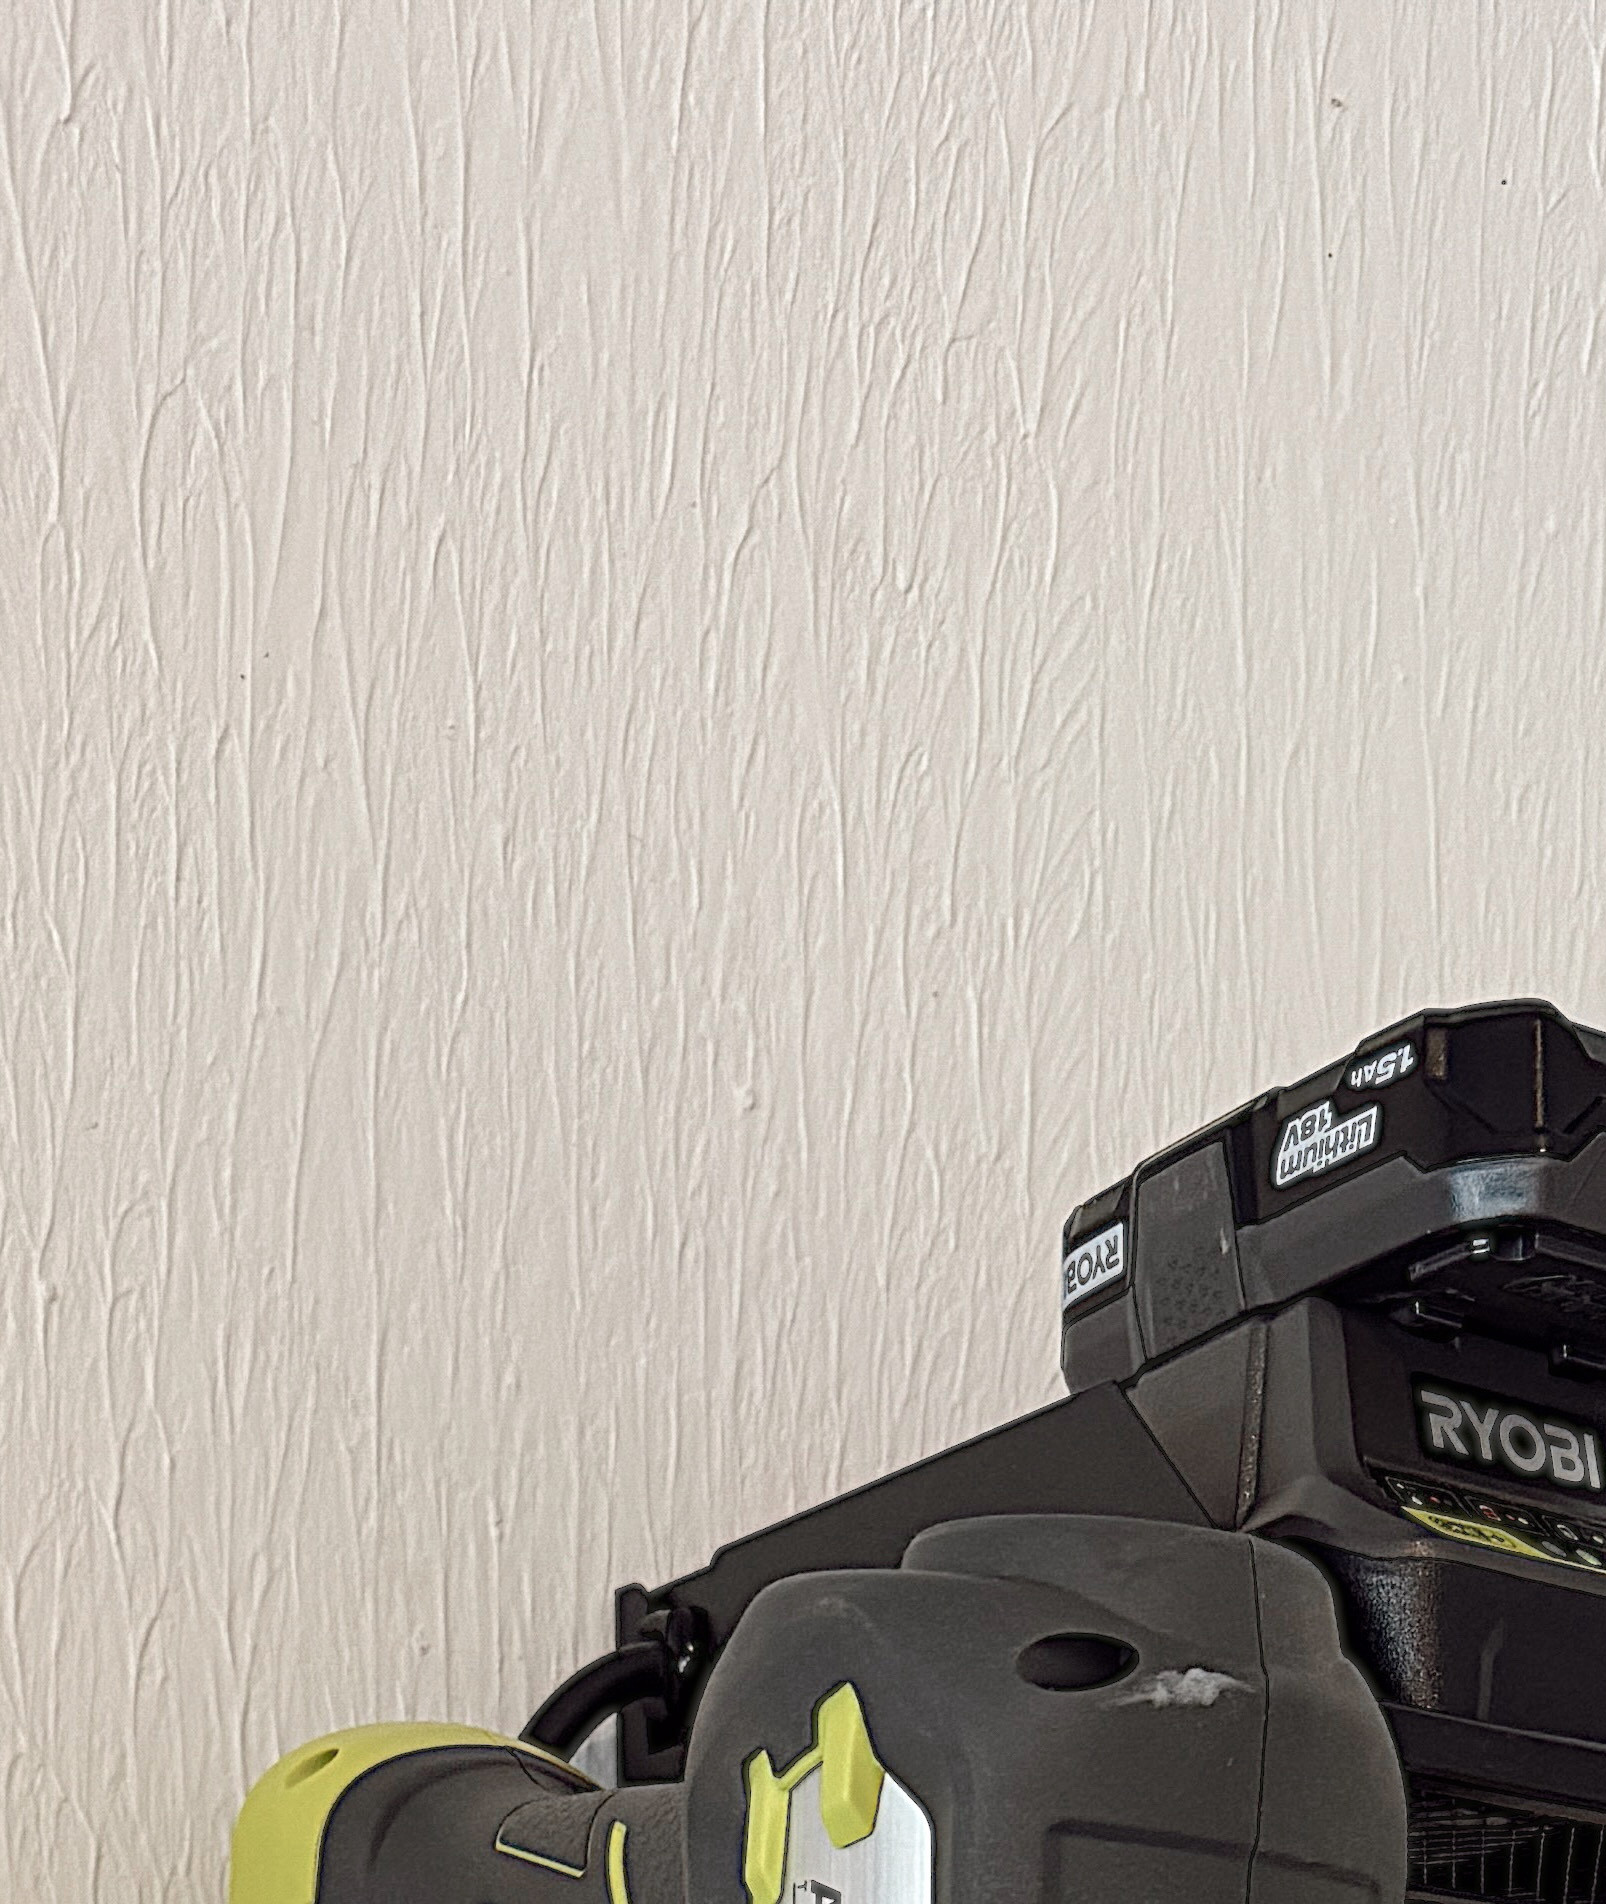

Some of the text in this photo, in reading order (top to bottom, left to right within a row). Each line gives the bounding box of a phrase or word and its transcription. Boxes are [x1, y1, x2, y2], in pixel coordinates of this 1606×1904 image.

[1351, 1044, 1413, 1087] 1.5Ah
[1280, 1114, 1372, 1179] Lithium
[1284, 1108, 1328, 1152] 18V
[1421, 1390, 1601, 1488] RYOBI
